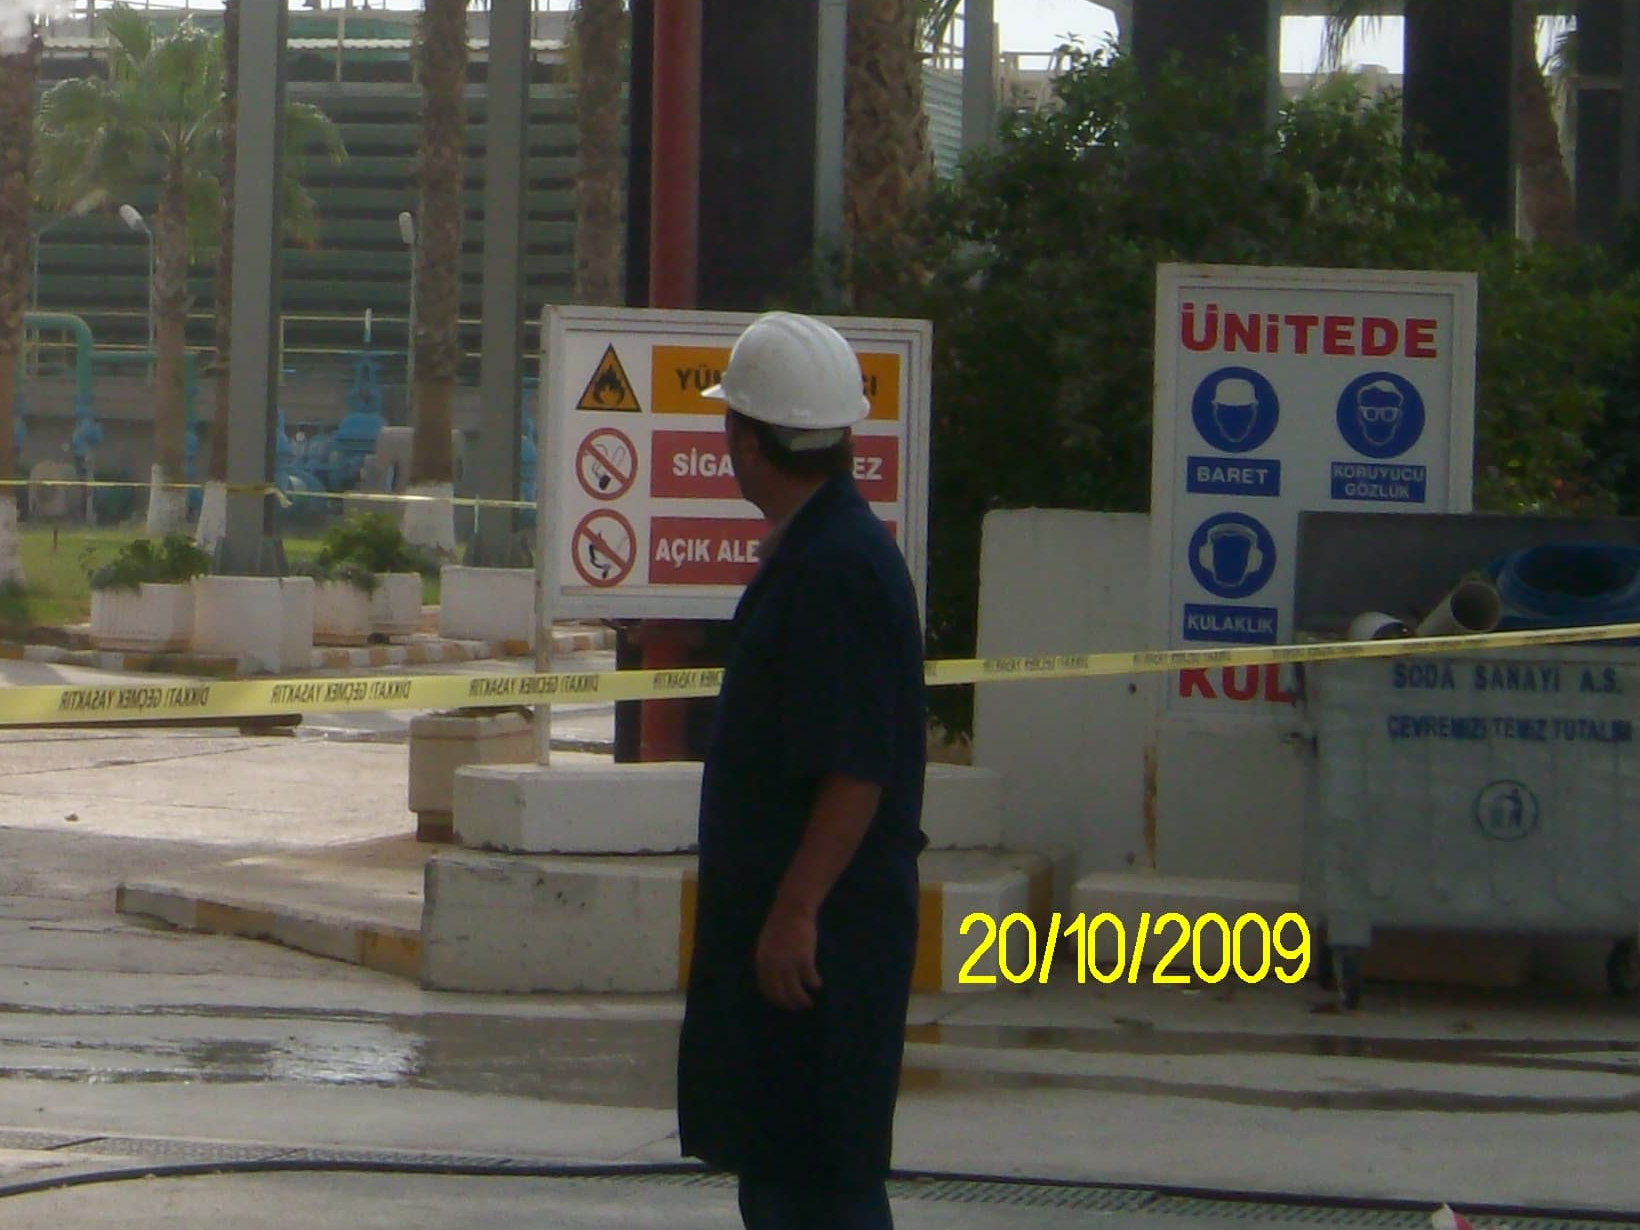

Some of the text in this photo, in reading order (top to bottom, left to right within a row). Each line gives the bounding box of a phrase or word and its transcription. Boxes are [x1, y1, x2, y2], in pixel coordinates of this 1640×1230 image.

[672, 447, 735, 477] SİGA
[1196, 465, 1268, 484] BARET
[1333, 465, 1425, 482] KORUYUCU
[655, 537, 760, 568] AÇIK ALE
[1187, 614, 1274, 634] KULAKLIK
[1178, 662, 1294, 703] KUL
[1393, 661, 1456, 689] SODA
